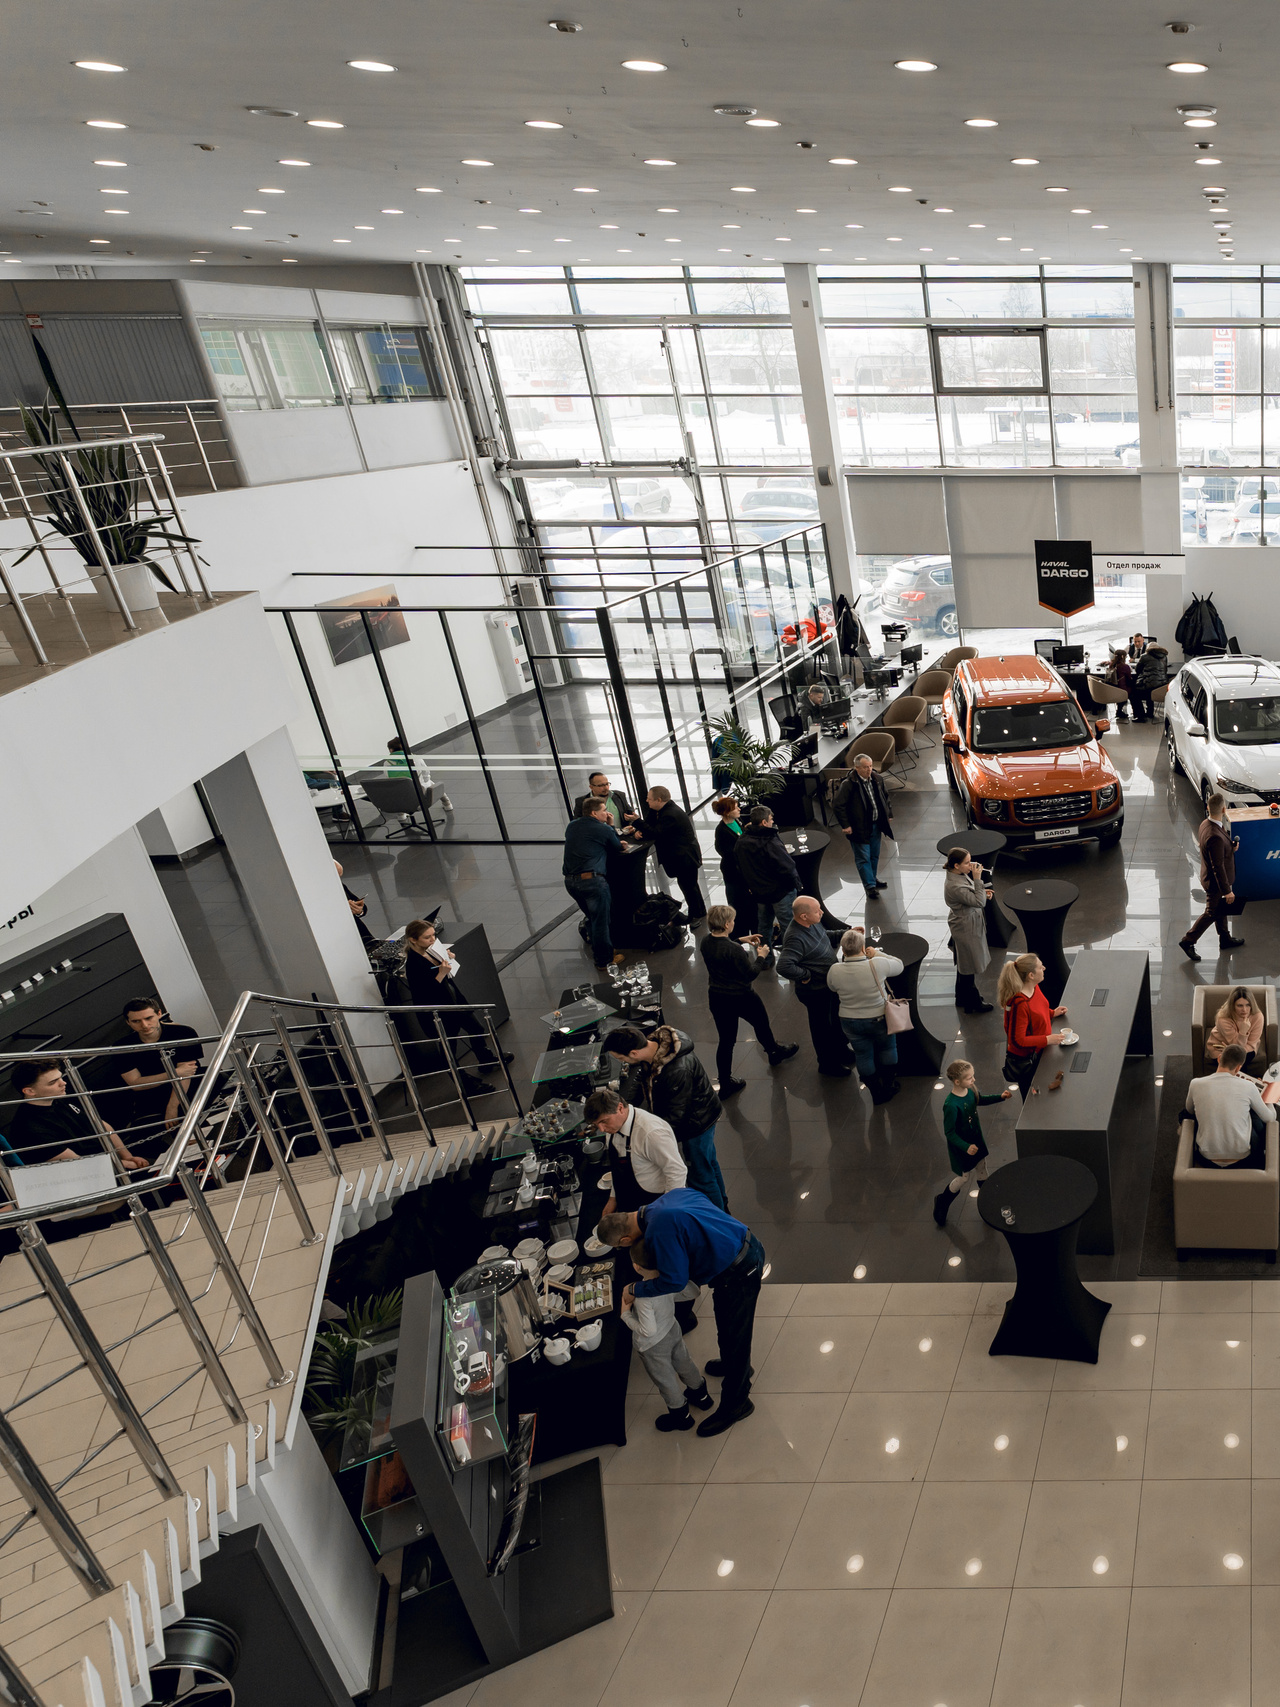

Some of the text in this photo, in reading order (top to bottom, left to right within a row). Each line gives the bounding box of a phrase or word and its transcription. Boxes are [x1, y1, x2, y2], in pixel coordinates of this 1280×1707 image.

[1106, 561, 1161, 570] Отдел продаж
[1041, 569, 1089, 578] DARGO
[1043, 829, 1071, 837] DARGO
